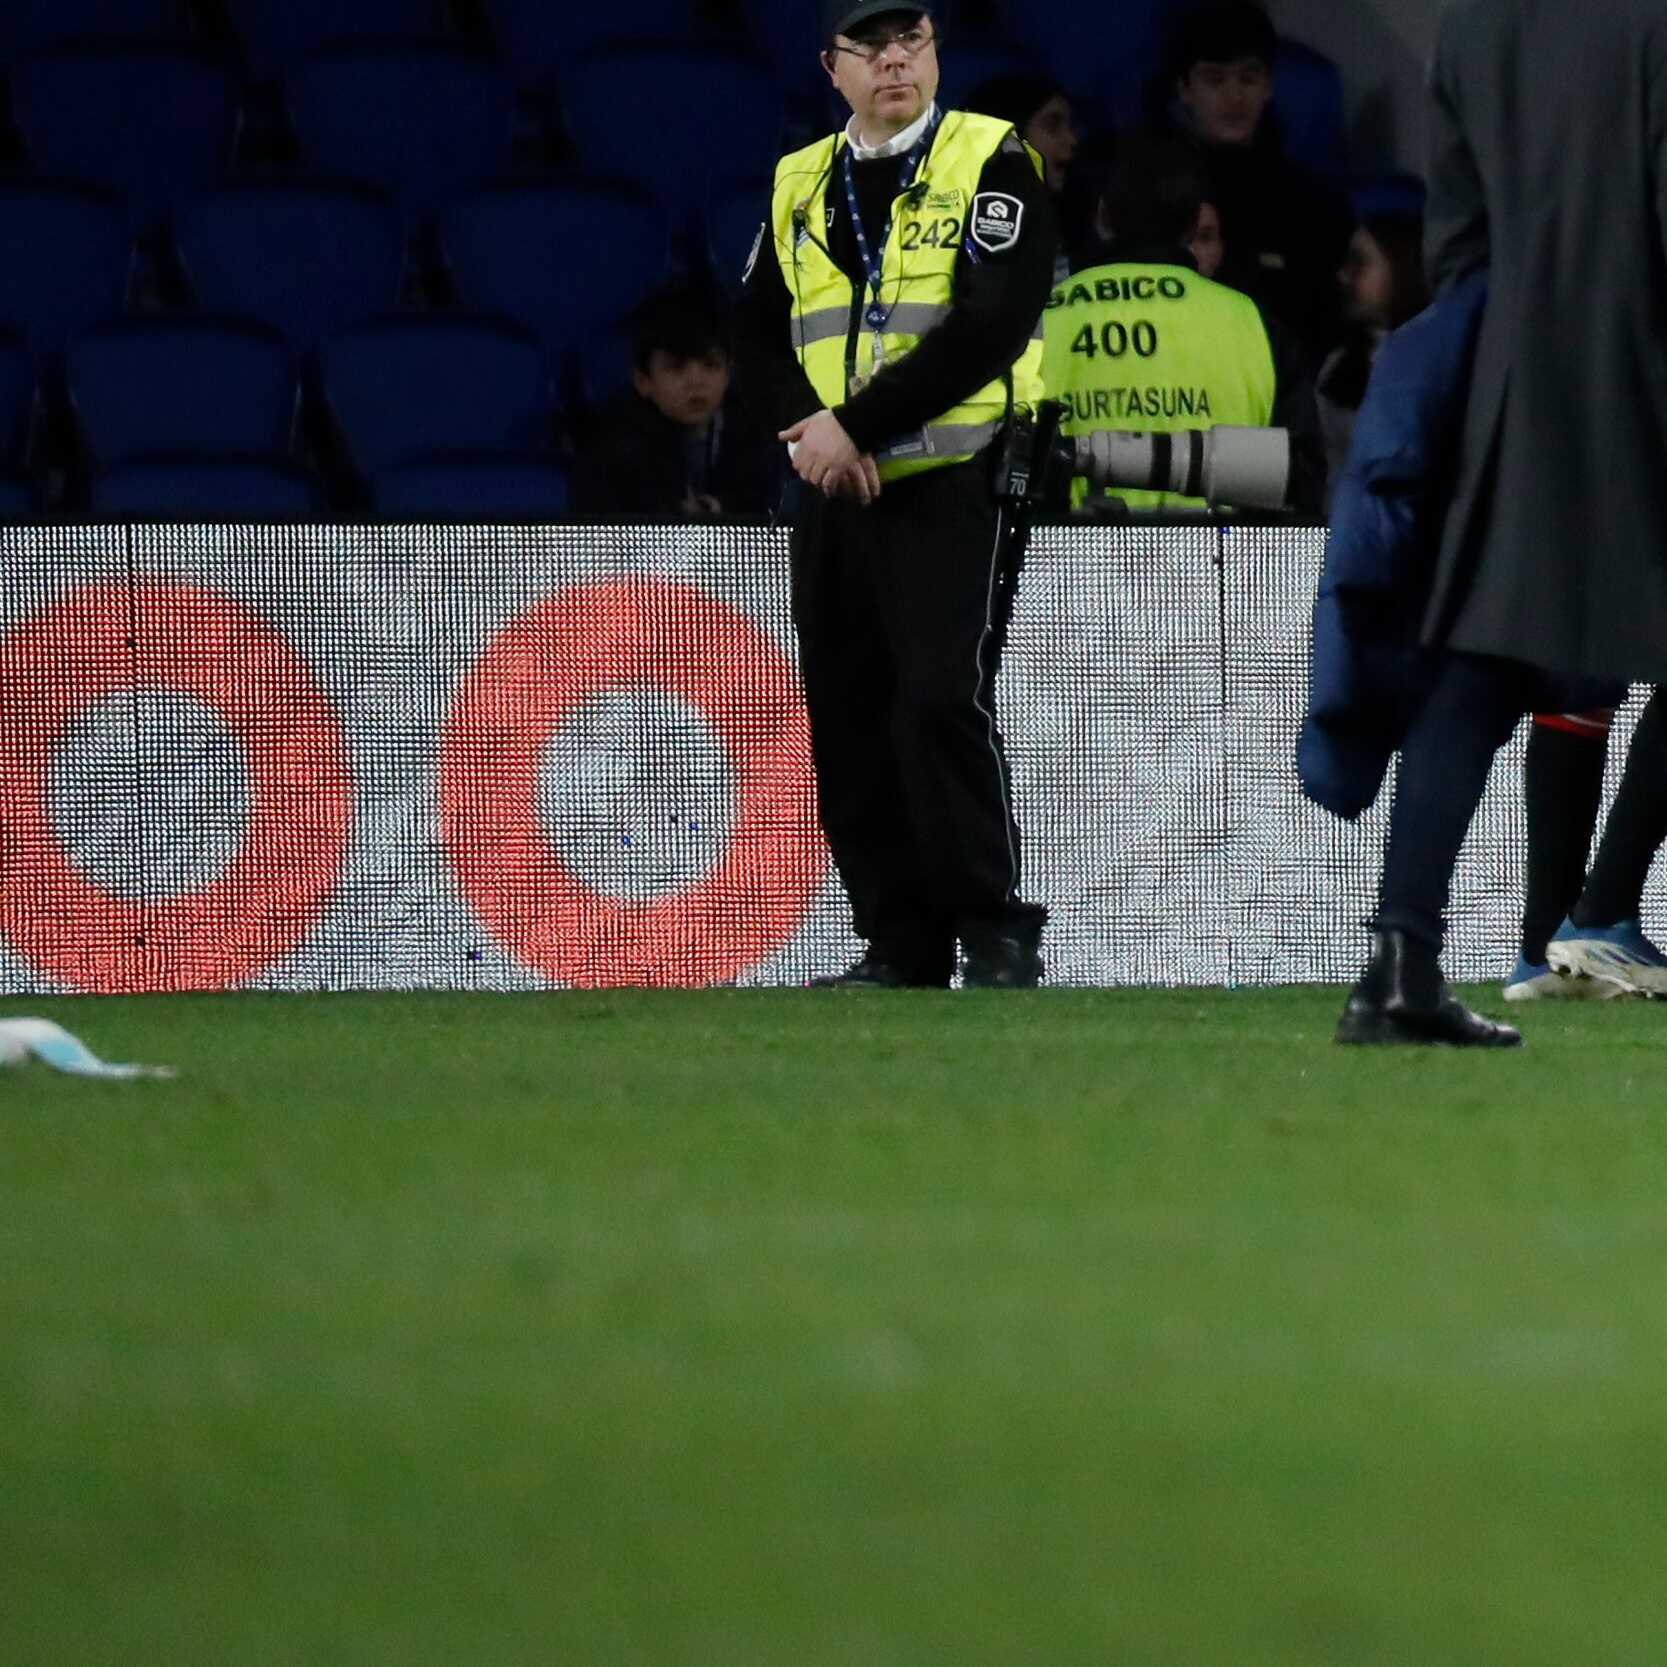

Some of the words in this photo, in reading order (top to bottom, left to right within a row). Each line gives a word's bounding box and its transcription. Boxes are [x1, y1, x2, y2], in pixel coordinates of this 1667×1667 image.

[901, 217, 961, 251] 242
[1045, 276, 1186, 310] SABICO
[1070, 318, 1157, 358] 400
